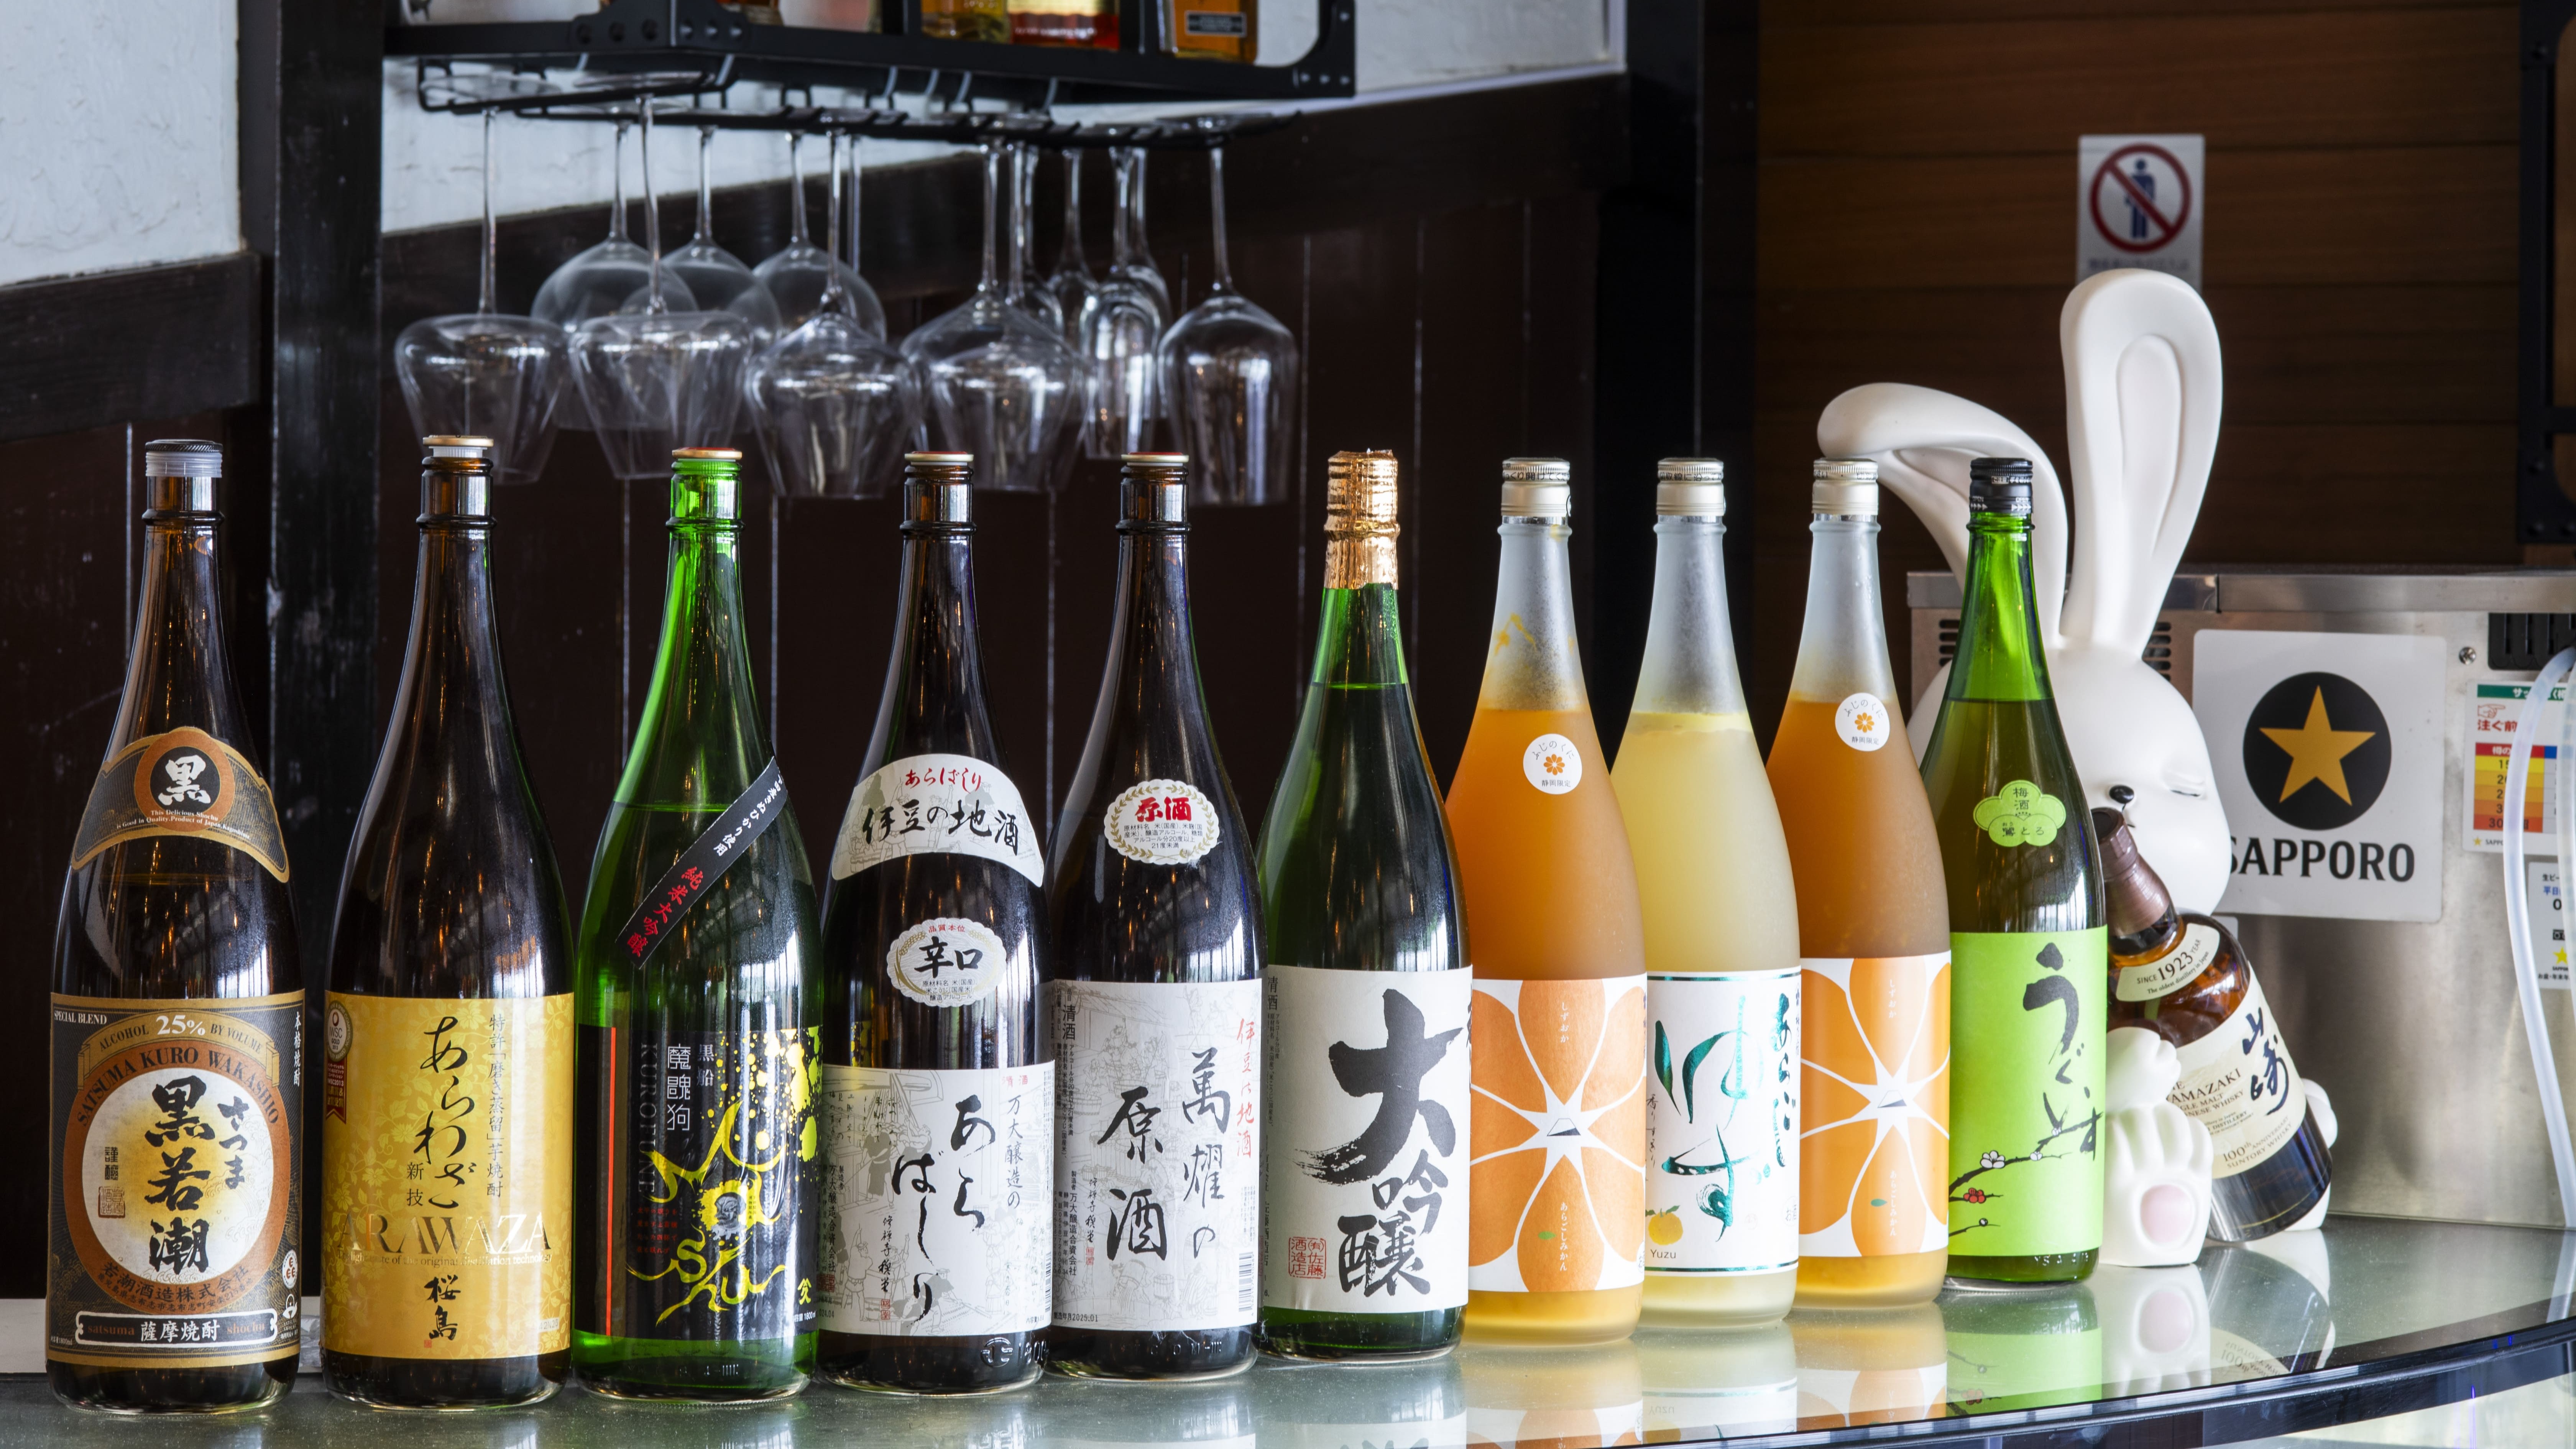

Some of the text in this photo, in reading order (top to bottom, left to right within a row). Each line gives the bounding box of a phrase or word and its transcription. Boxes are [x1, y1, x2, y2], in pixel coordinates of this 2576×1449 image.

[1844, 700, 1883, 719] ふじのくに
[1532, 741, 1574, 760] ふじのくに
[1852, 736, 1879, 745] 静岡限定
[158, 754, 211, 805] 黒
[904, 767, 982, 794] あらばしり
[1542, 779, 1571, 787] 静岡限定
[2013, 787, 2030, 810] 梅酒
[196, 810, 218, 821] Shochu
[862, 799, 1018, 856] 伊豆の地酒
[1135, 796, 1192, 822] 原酒
[626, 866, 703, 958] 純米大吟醸
[928, 924, 966, 933] 品質本位
[914, 936, 983, 979] 辛口
[2137, 939, 2201, 984] SINCE 1923 YEAR
[2159, 981, 2175, 991] oldest
[2175, 968, 2196, 984] distillery
[2199, 951, 2209, 964] Japan
[929, 993, 972, 1001] 醸造アルコール
[1268, 976, 1278, 1010] 清酒
[54, 1010, 107, 1025] SPECIAL BLEND
[99, 1015, 262, 1055] ALCOHOL 25% BY VOLUME
[1062, 1004, 1076, 1041] 清酒
[1560, 1001, 1569, 1043] しずおか
[293, 1011, 302, 1087] 本格焼酎
[696, 1043, 715, 1086] 黒船
[77, 1047, 279, 1127] SATSUMA KURO WAKASHIO
[1002, 1074, 1028, 1089] 清酒
[2180, 1092, 2224, 1111] GLE MALT
[413, 1016, 477, 1209] あらわざ
[486, 1014, 506, 1198] 特許「磨き蒸留」芋焼酎
[639, 1042, 657, 1193] KUROFUNE
[2185, 1089, 2244, 1117] NESE WHISKY
[2212, 1111, 2247, 1130] DISTILLERY
[217, 1096, 250, 1189] さつま
[1004, 1094, 1024, 1209] 万大醸造の
[1291, 988, 1464, 1298] 大吟醸
[2223, 1141, 2252, 1162] 100th
[2227, 1120, 2292, 1168] SUNTORY WHISKY
[144, 1075, 215, 1275] 黒若潮
[406, 1162, 424, 1207] 新技
[1097, 1086, 1168, 1262] 原酒
[336, 1211, 552, 1255] ARAWAZA
[828, 1165, 836, 1273] 万大醸造合資会社
[1068, 1192, 1078, 1276] 万大醸造合資会社
[1560, 1201, 1568, 1271] あらごしみかん
[391, 1255, 402, 1264] of
[404, 1255, 418, 1265] the
[421, 1256, 458, 1268] original
[513, 1253, 553, 1266] technology
[1291, 1239, 1306, 1276] 酒造店
[1650, 1249, 1676, 1259] Yuzu
[102, 1261, 249, 1303] 若潮酒造株式会社
[424, 1274, 461, 1341] 桜島
[818, 1308, 835, 1318] 024.04
[87, 1324, 135, 1336] satsuma
[140, 1319, 220, 1342] 薩摩焼酎
[227, 1322, 265, 1335] shochu
